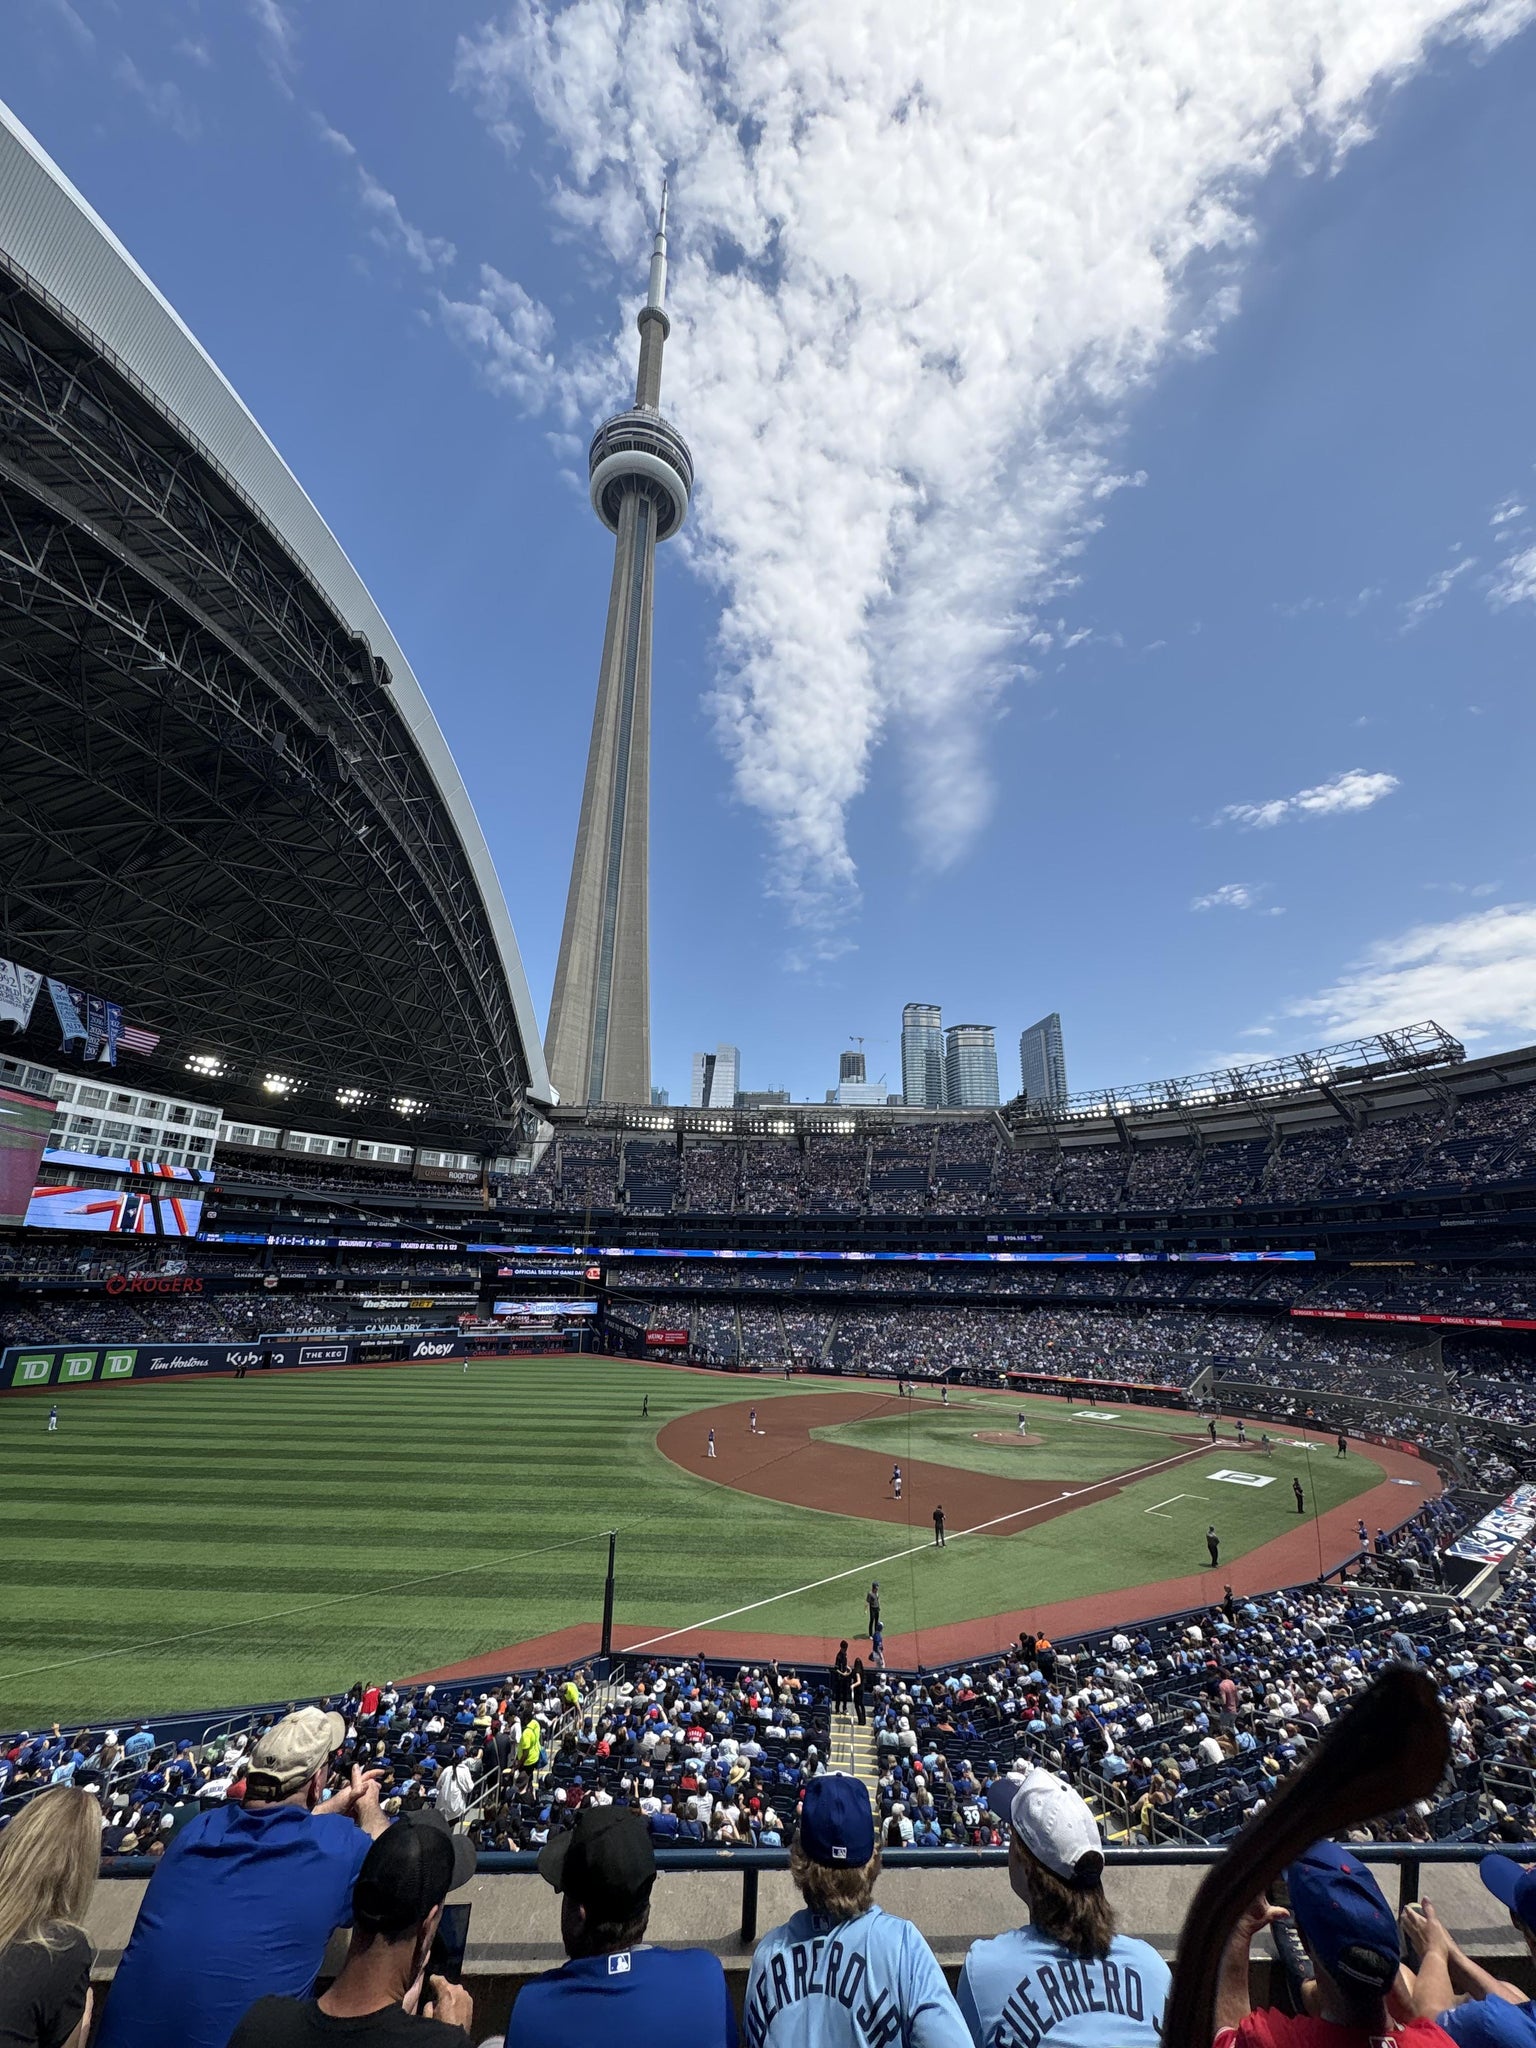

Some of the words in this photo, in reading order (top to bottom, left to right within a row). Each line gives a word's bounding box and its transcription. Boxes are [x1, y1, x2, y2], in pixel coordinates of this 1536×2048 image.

[449, 1172, 478, 1180] ROOFTOP
[131, 1277, 204, 1292] ROGERS
[363, 1300, 409, 1310] theScore
[404, 1323, 421, 1331] DRY
[413, 1341, 454, 1357] Sobeys
[21, 1361, 50, 1379] TD
[66, 1358, 92, 1376] TD
[107, 1355, 132, 1373] TD
[150, 1357, 168, 1370] Tim
[169, 1355, 209, 1368] Hortons
[964, 1810, 980, 1825] 39
[747, 1940, 867, 2048] UERRERO
